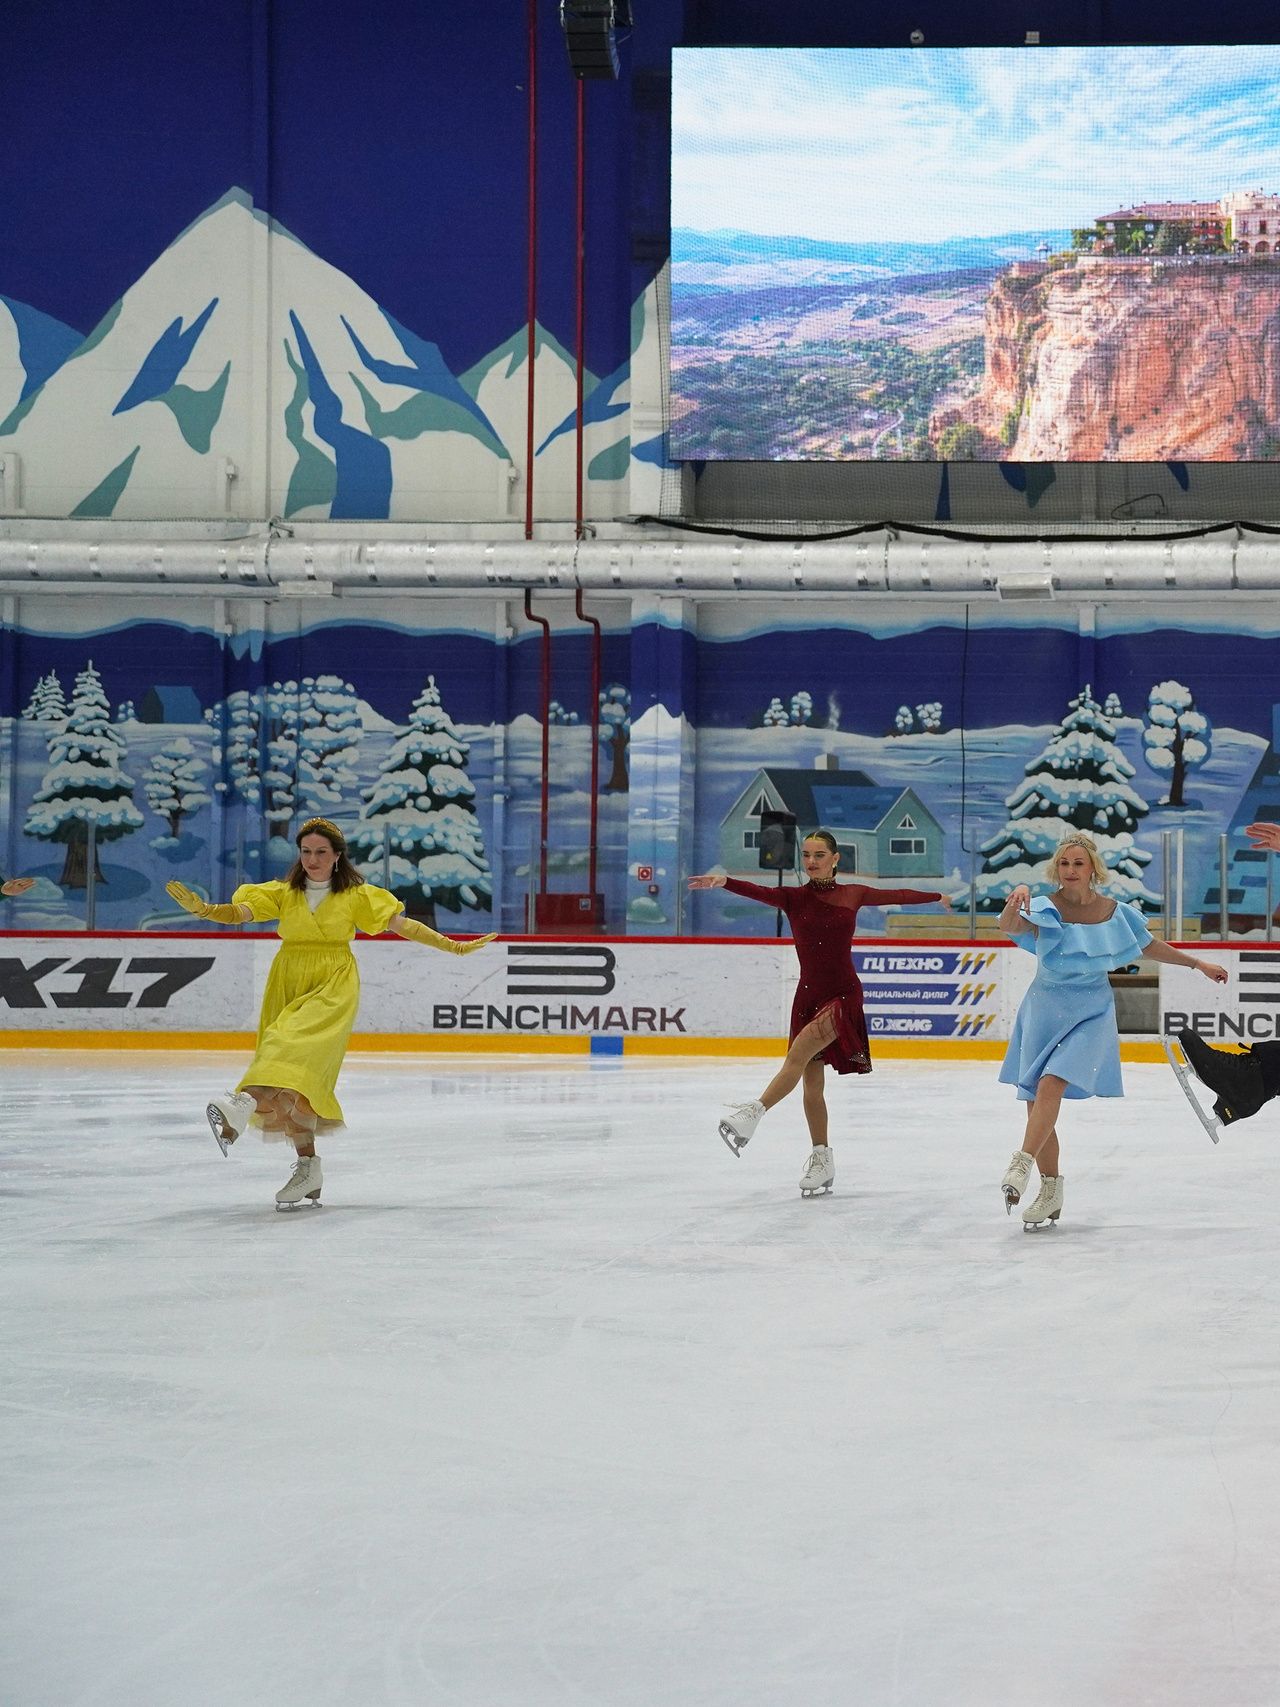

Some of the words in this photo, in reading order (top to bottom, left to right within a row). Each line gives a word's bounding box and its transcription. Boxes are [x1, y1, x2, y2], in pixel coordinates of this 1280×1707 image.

[862, 957, 886, 972] ГЦ
[887, 957, 944, 971] ТЕХНО
[863, 990, 921, 999] ФИЦИАЛЬНЫЙ
[922, 991, 949, 999] ДИЛЕР
[433, 1004, 686, 1032] BENCHMARK
[883, 1019, 933, 1032] XCMG
